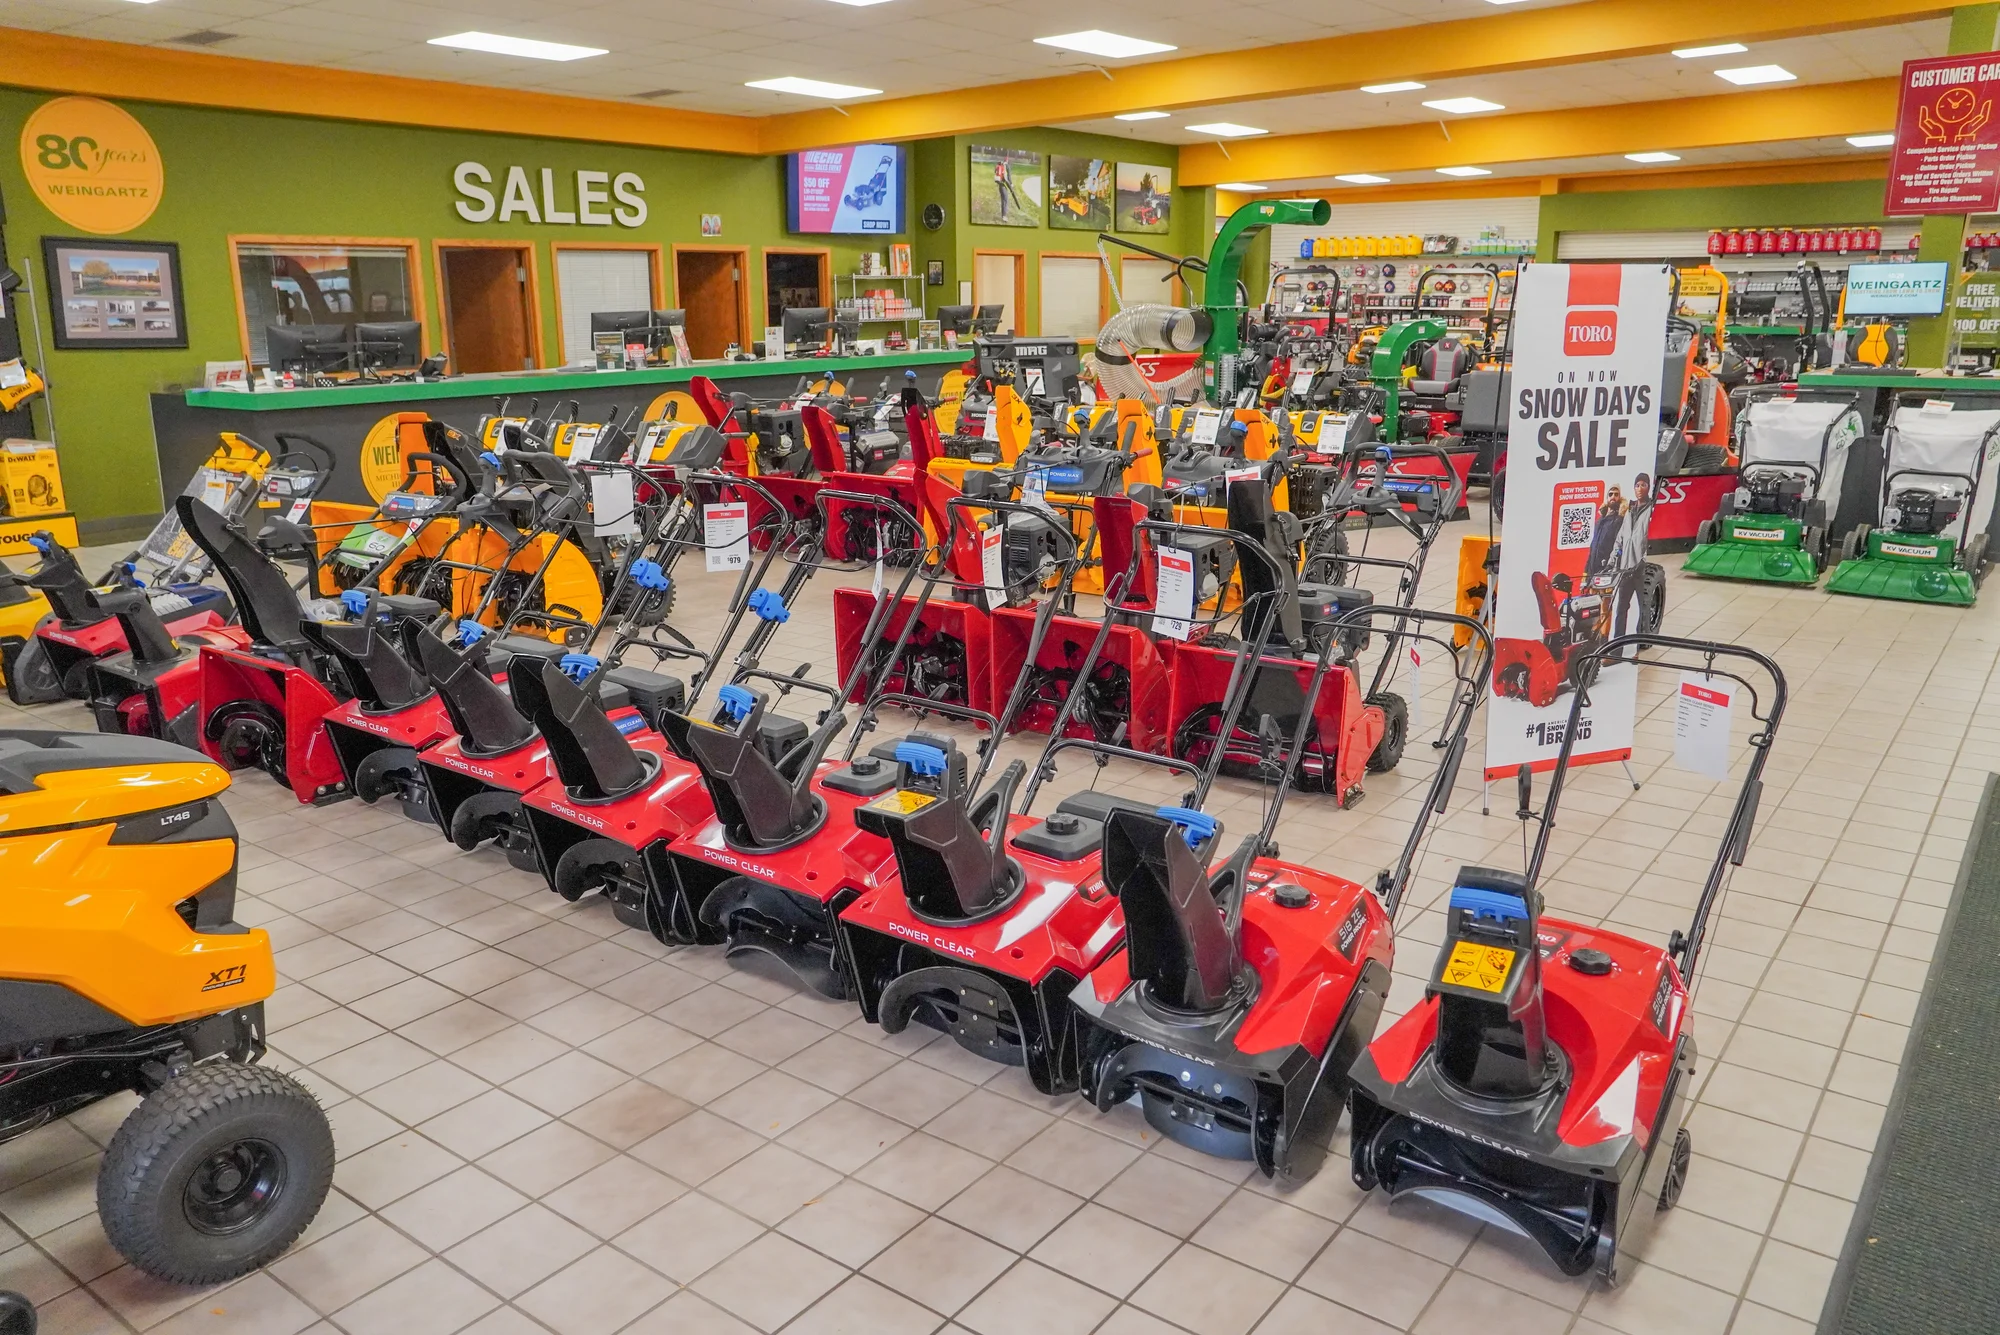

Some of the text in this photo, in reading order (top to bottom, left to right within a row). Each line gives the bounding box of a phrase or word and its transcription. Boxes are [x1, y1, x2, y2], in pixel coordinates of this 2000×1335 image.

[1911, 63, 2000, 88] CUSTOMER CAR
[35, 134, 98, 171] 80
[806, 151, 843, 165] ECHO
[48, 185, 149, 198] WEINGARTZ
[803, 177, 830, 188] $50 OFF
[454, 161, 648, 228] SALES
[1851, 280, 1942, 289] WEINGARTZ
[1967, 284, 1996, 296] FREE
[1956, 296, 2000, 308] ELIVER
[1569, 325, 1612, 343] TORO
[1558, 370, 1617, 383] ON NOW
[1519, 384, 1651, 419] SNOW DAYS
[1535, 419, 1629, 471] SALE
[1749, 531, 1779, 539] VACUUM
[1898, 547, 1931, 556] VACUUM
[346, 716, 389, 734] POWER CLEAR
[1526, 722, 1546, 746] #1
[1547, 724, 1566, 732] SNOW
[1546, 728, 1592, 745] BRND
[445, 757, 494, 779] POWER CLEAR
[161, 811, 191, 826] LT46
[551, 802, 603, 830] POWER CLEAR
[704, 849, 775, 879] POWER CLEAR
[888, 921, 975, 959] POWER CLEAR
[205, 964, 247, 985] XT1
[1120, 1029, 1215, 1067] POWER CLEAR
[1409, 1110, 1530, 1159] POWER CLEAR
